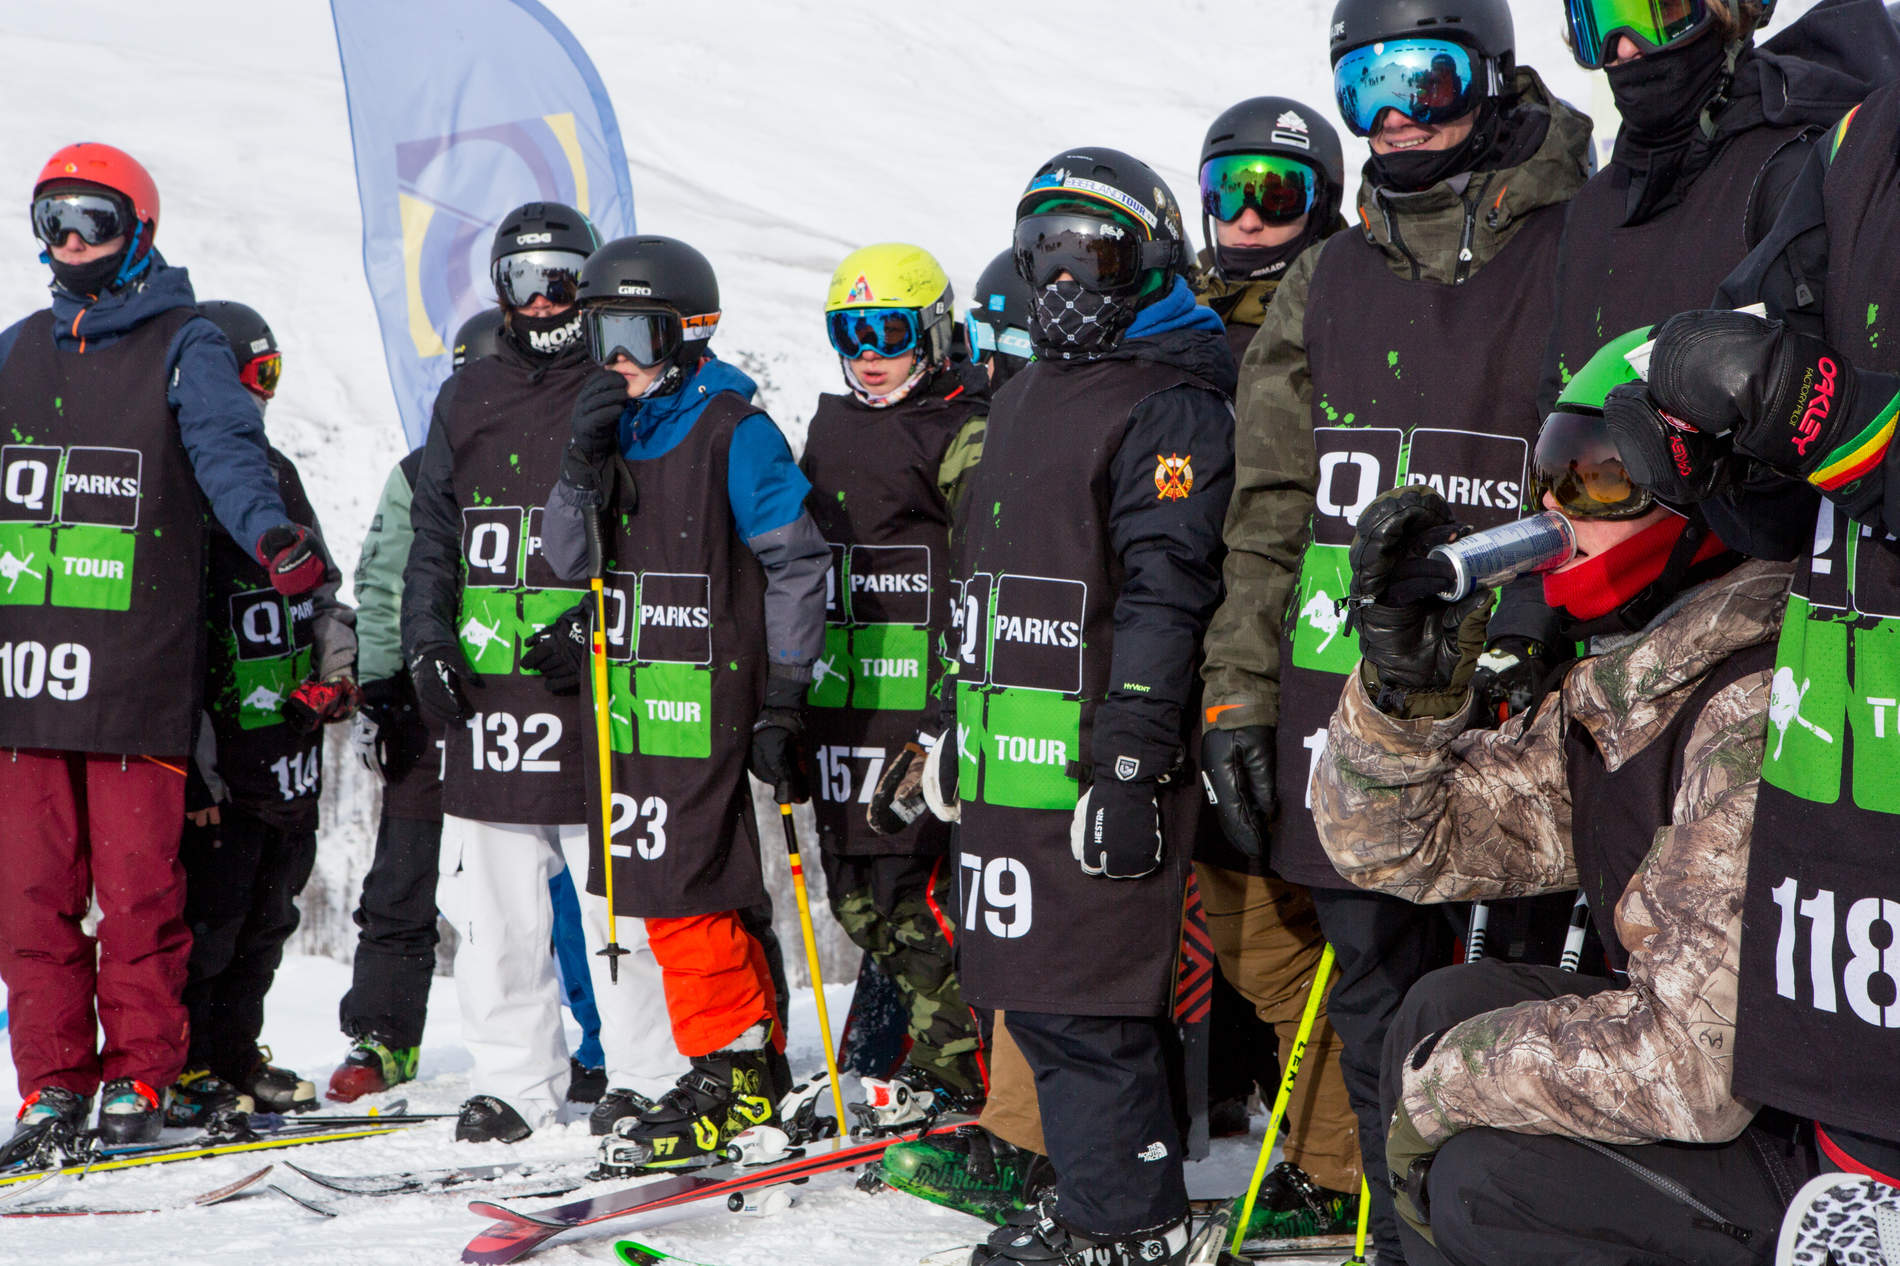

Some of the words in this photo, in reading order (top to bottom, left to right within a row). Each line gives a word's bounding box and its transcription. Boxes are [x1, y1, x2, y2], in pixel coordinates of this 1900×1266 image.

[618, 286, 652, 296] GIRO
[1792, 356, 1838, 456] OAKLEY
[5, 460, 48, 510] Q
[63, 474, 138, 497] PARKS
[1316, 451, 1380, 527] Q
[62, 556, 125, 579] TOUR
[468, 522, 510, 574] Q
[850, 574, 929, 593] PARKS
[242, 600, 283, 646] Q
[640, 604, 710, 629] PARKS
[994, 614, 1081, 649] PARKS
[0, 640, 92, 702] 109
[860, 658, 919, 678] TOUR
[644, 698, 703, 723] TOUR
[466, 712, 563, 772] 132
[994, 734, 1068, 766] TOUR
[270, 745, 319, 801] 114
[816, 744, 887, 804] 157
[1094, 807, 1105, 844] HESTRA
[1772, 877, 1900, 1030] 118
[1285, 1040, 1307, 1094] LEKI
[652, 1136, 680, 1157] FT
